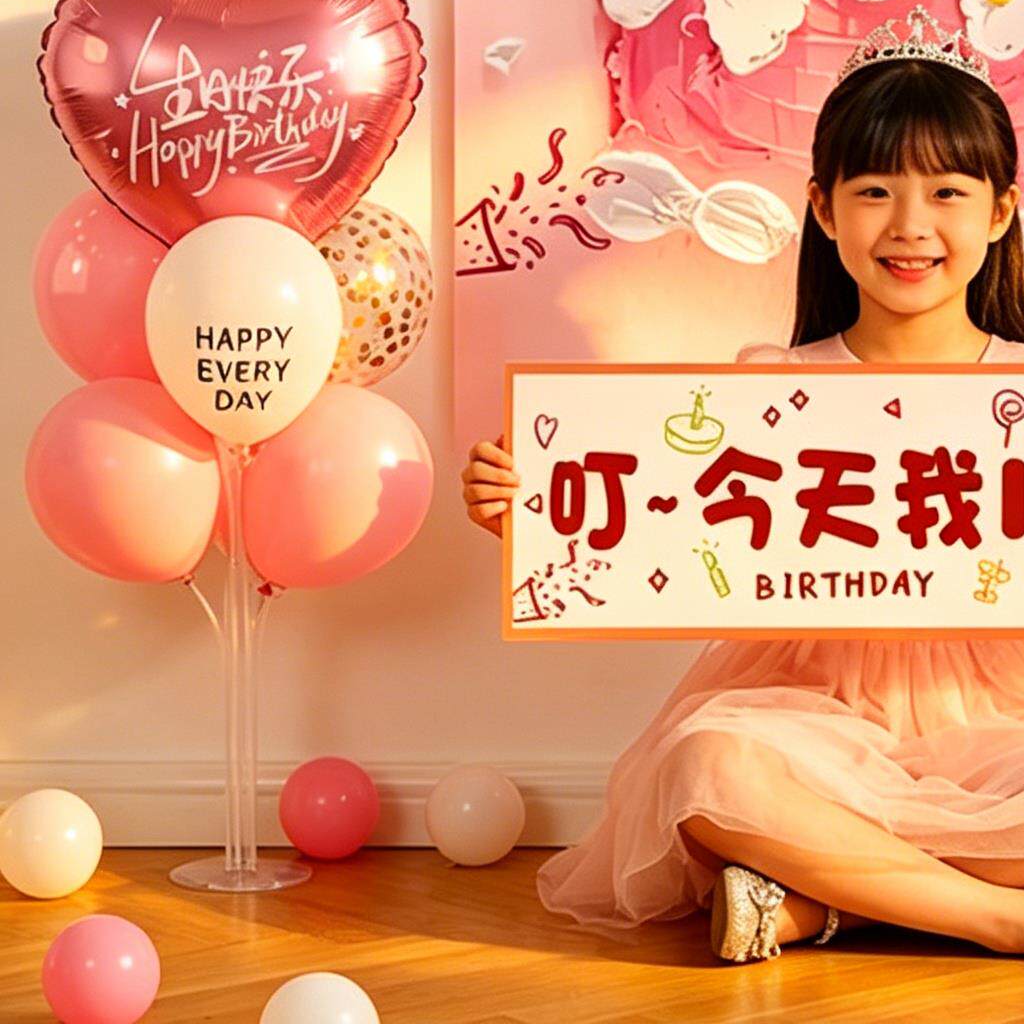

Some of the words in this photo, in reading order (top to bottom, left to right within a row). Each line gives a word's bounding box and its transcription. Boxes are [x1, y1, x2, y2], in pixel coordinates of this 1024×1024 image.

[195, 326, 293, 351] HAPPY
[197, 359, 290, 382] EVERY
[213, 390, 272, 411] DAY
[755, 570, 934, 601] BIRTHDAY
